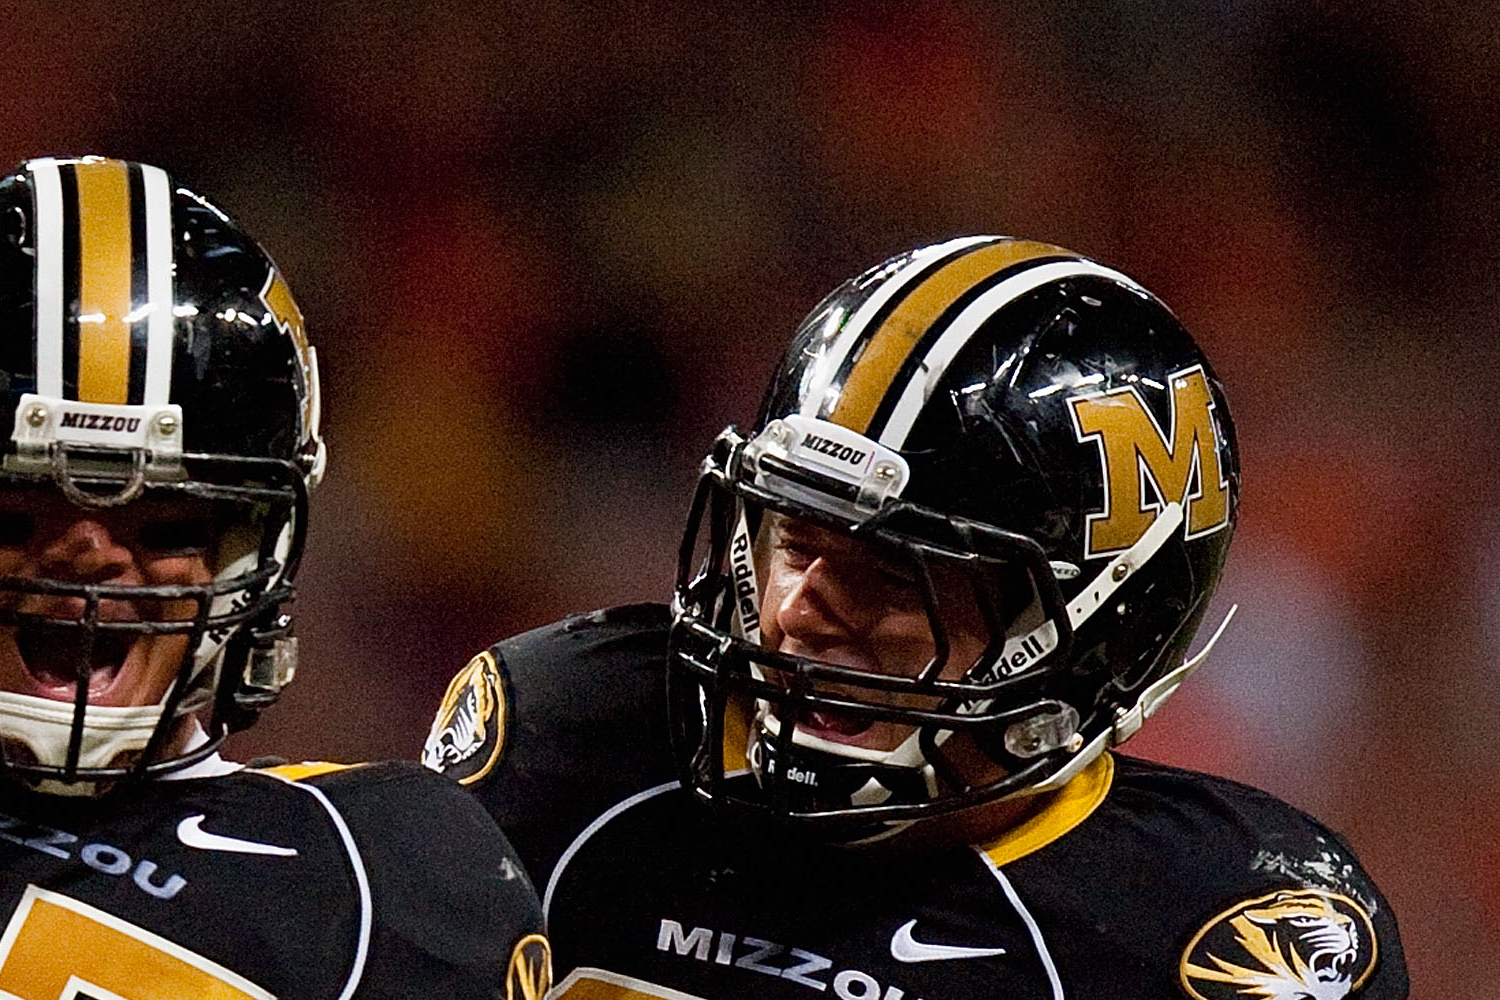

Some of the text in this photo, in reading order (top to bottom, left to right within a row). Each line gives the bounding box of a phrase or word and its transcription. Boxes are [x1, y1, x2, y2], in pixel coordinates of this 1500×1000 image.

[60, 412, 141, 433] MIZZOU
[800, 433, 866, 465] MIZZOU
[1066, 363, 1229, 560] M
[733, 533, 760, 634] Riddell
